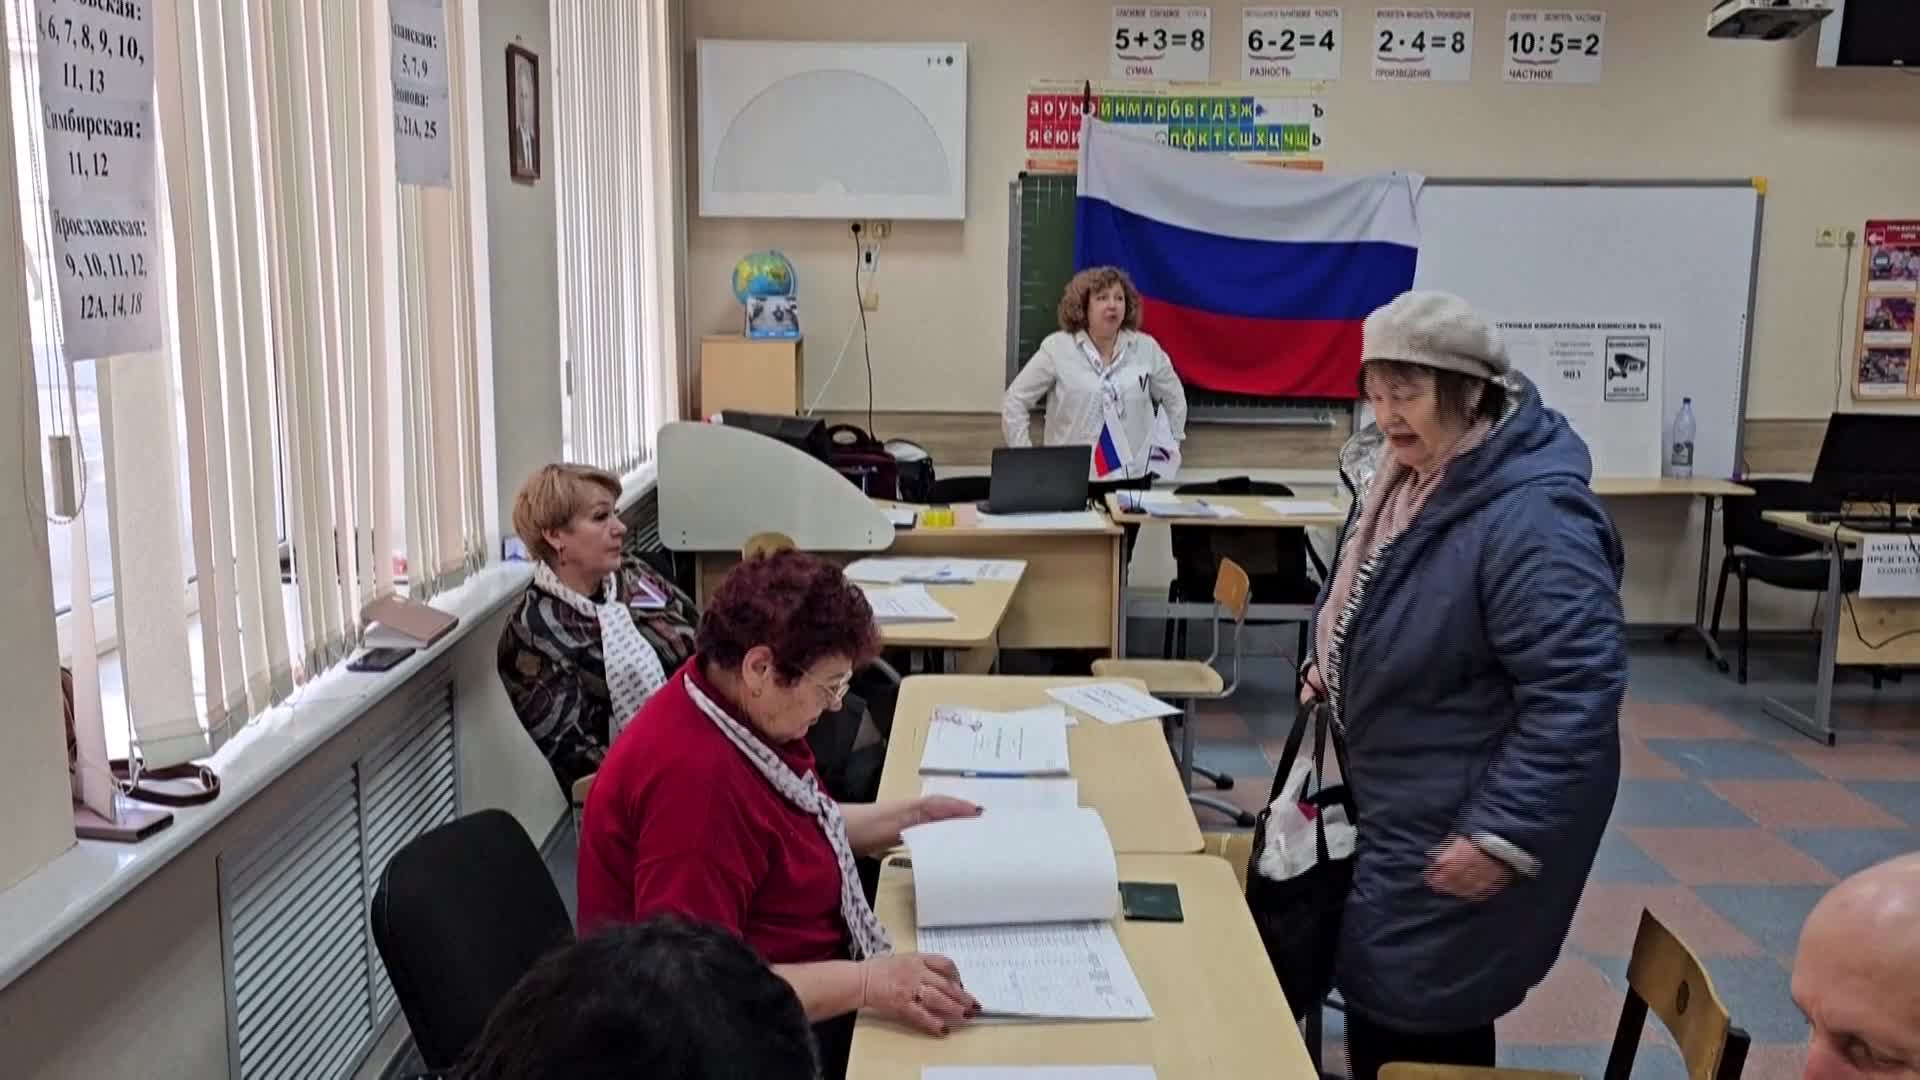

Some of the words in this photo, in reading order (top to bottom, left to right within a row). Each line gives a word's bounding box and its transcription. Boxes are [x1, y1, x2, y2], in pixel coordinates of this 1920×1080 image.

[48, 15, 60, 44] 6,
[64, 18, 77, 48] 7,
[81, 24, 95, 54] 8,
[99, 29, 112, 58] 9,
[119, 34, 144, 66] 10,
[64, 62, 83, 93] 11,
[90, 68, 104, 93] 13
[1125, 66, 1153, 76] СУММА
[1250, 67, 1291, 77] РАЗНОСТЬ
[1509, 69, 1553, 80] ЧАСТНОЕ
[44, 104, 141, 141] Симбирская:
[69, 151, 88, 180] 11,
[93, 152, 108, 176] 12
[54, 209, 147, 242] Ярославская:
[65, 253, 84, 280] 9,
[84, 253, 107, 279] 10,
[109, 253, 128, 278] 11,
[130, 292, 142, 315] 18
